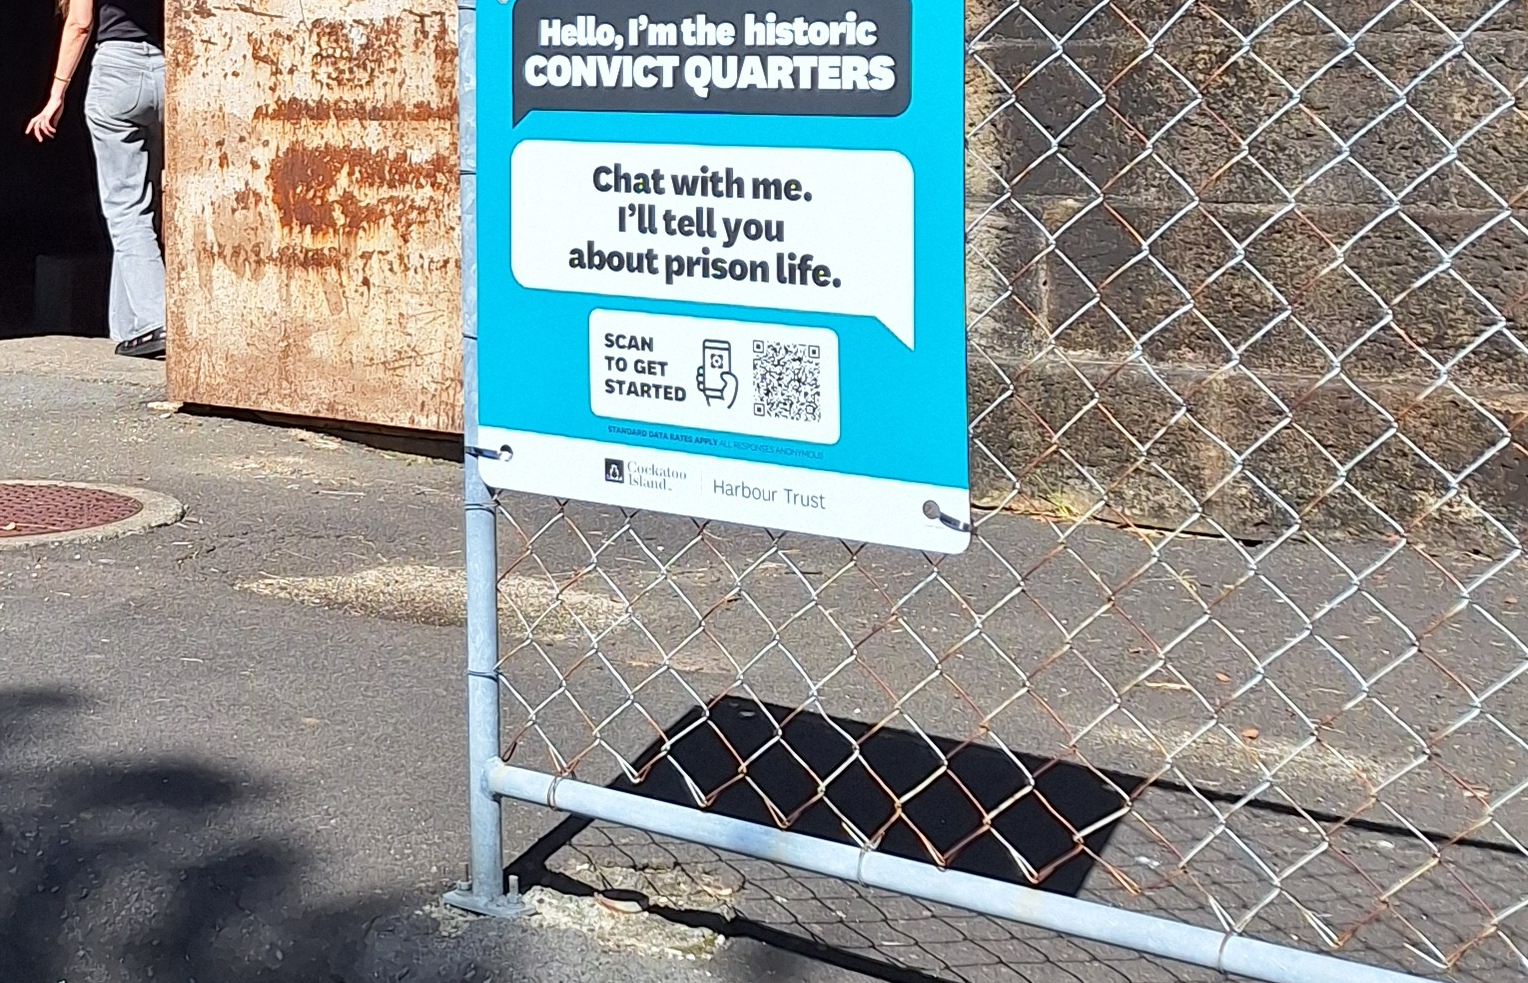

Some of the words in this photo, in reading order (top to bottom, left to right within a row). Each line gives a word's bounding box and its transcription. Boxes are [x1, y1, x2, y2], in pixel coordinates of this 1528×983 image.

[540, 15, 624, 51] Hello,
[628, 14, 678, 46] I'm
[680, 14, 736, 46] the
[744, 10, 878, 46] historic
[525, 54, 680, 88] CONVICT
[684, 54, 896, 98] QUARTERS
[592, 163, 666, 195] Chat
[671, 165, 745, 198] with
[751, 177, 813, 202] me.
[618, 203, 658, 235] I'll
[662, 206, 717, 238] tell
[722, 217, 784, 248] you
[568, 240, 660, 275] about
[665, 246, 769, 285] prison
[776, 252, 842, 288] life.
[604, 332, 654, 352] SCAN
[604, 355, 628, 372] TO
[633, 358, 669, 377] GET
[604, 378, 687, 402] STARTED
[607, 425, 647, 437] STANDARD
[648, 429, 669, 440] DATA
[669, 433, 693, 443] RATES
[694, 436, 718, 447] APPLY
[627, 460, 687, 479] Cockatoo
[713, 478, 778, 502] Harbour
[783, 488, 826, 510] Trust
